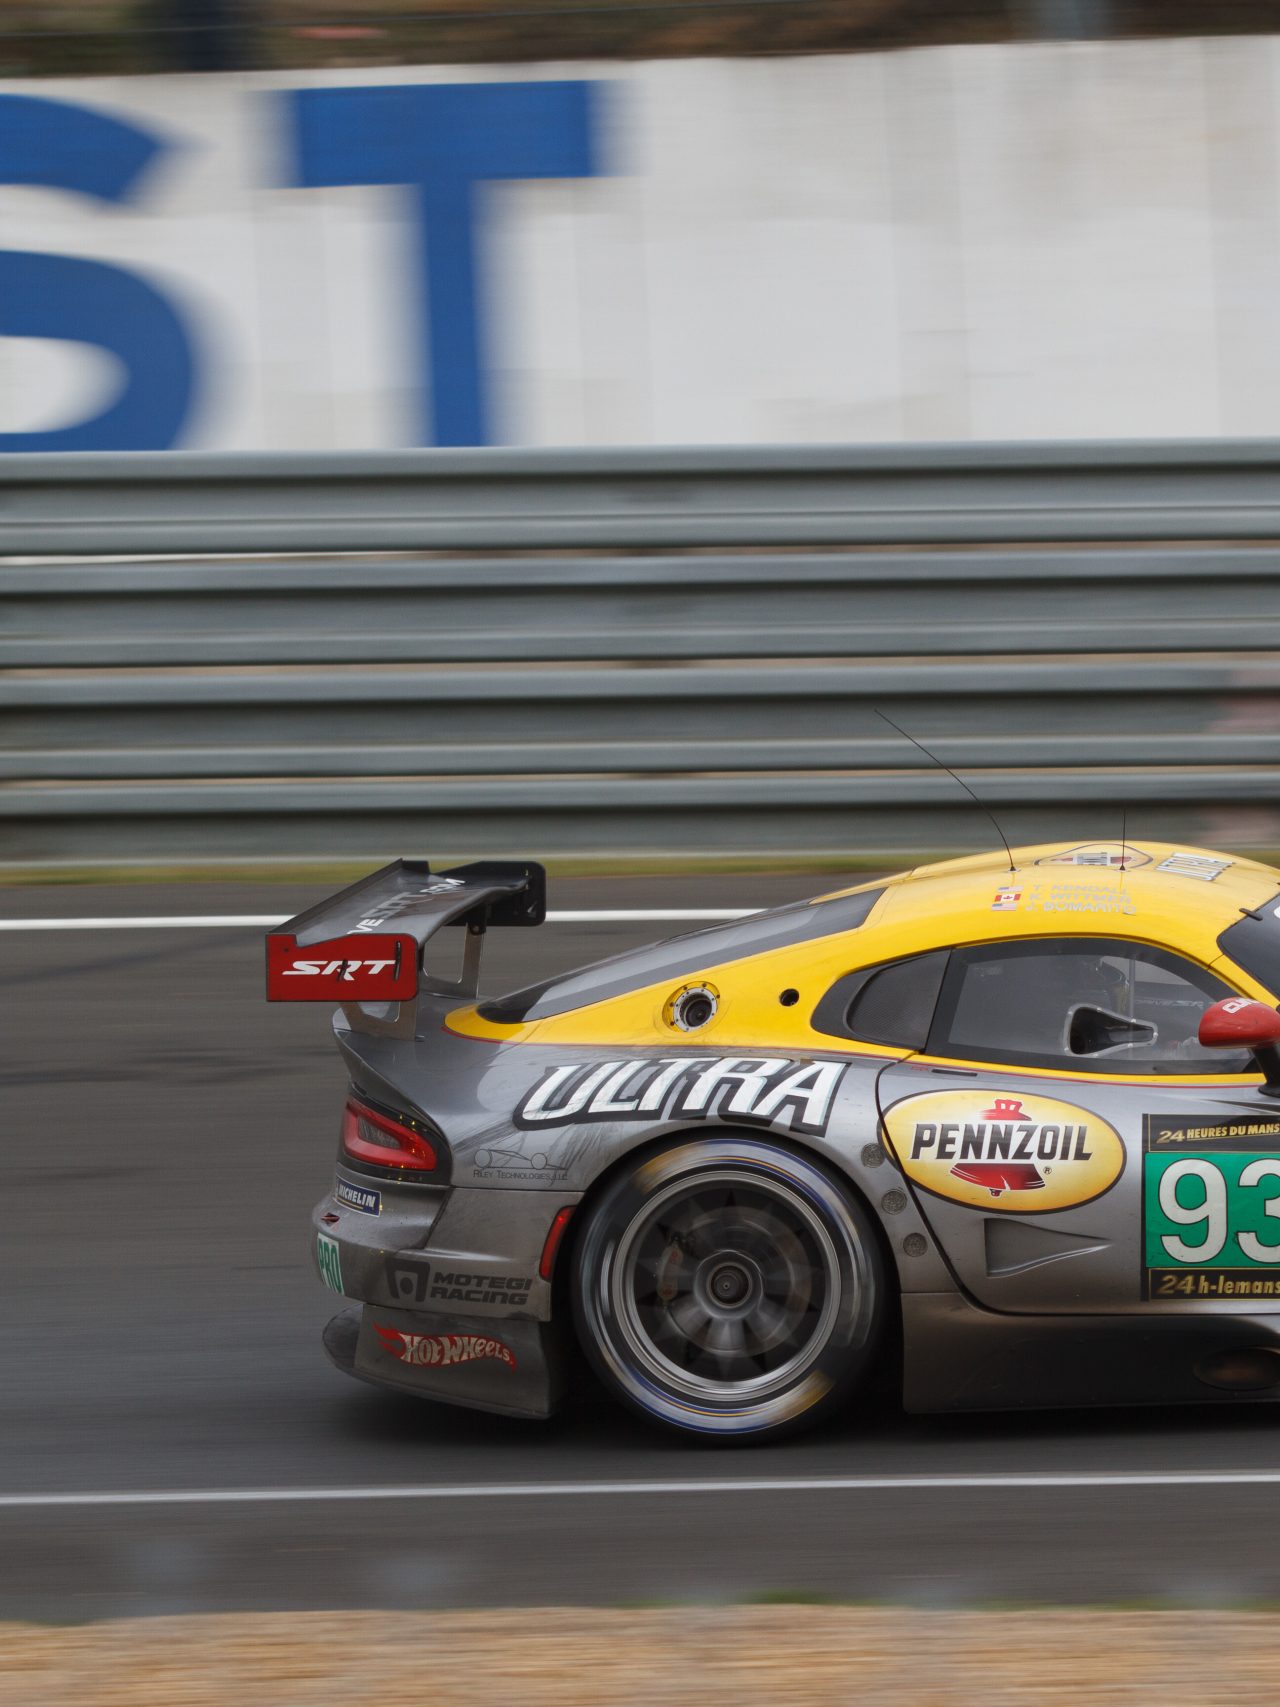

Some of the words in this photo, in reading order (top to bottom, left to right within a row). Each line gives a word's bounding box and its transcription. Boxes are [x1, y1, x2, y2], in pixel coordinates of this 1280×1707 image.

[283, 960, 396, 981] SRT
[512, 1057, 852, 1138] ULTRA
[910, 1122, 1093, 1161] PENNZOIL
[1156, 1130, 1185, 1144] 24
[1187, 1127, 1228, 1139] HEURES
[1229, 1126, 1246, 1135] DU
[1247, 1123, 1280, 1135] MANS
[336, 1182, 377, 1208] MICHELIN
[318, 1238, 343, 1295] PRO
[433, 1272, 533, 1290] MOTEGI
[430, 1287, 529, 1305] RACING
